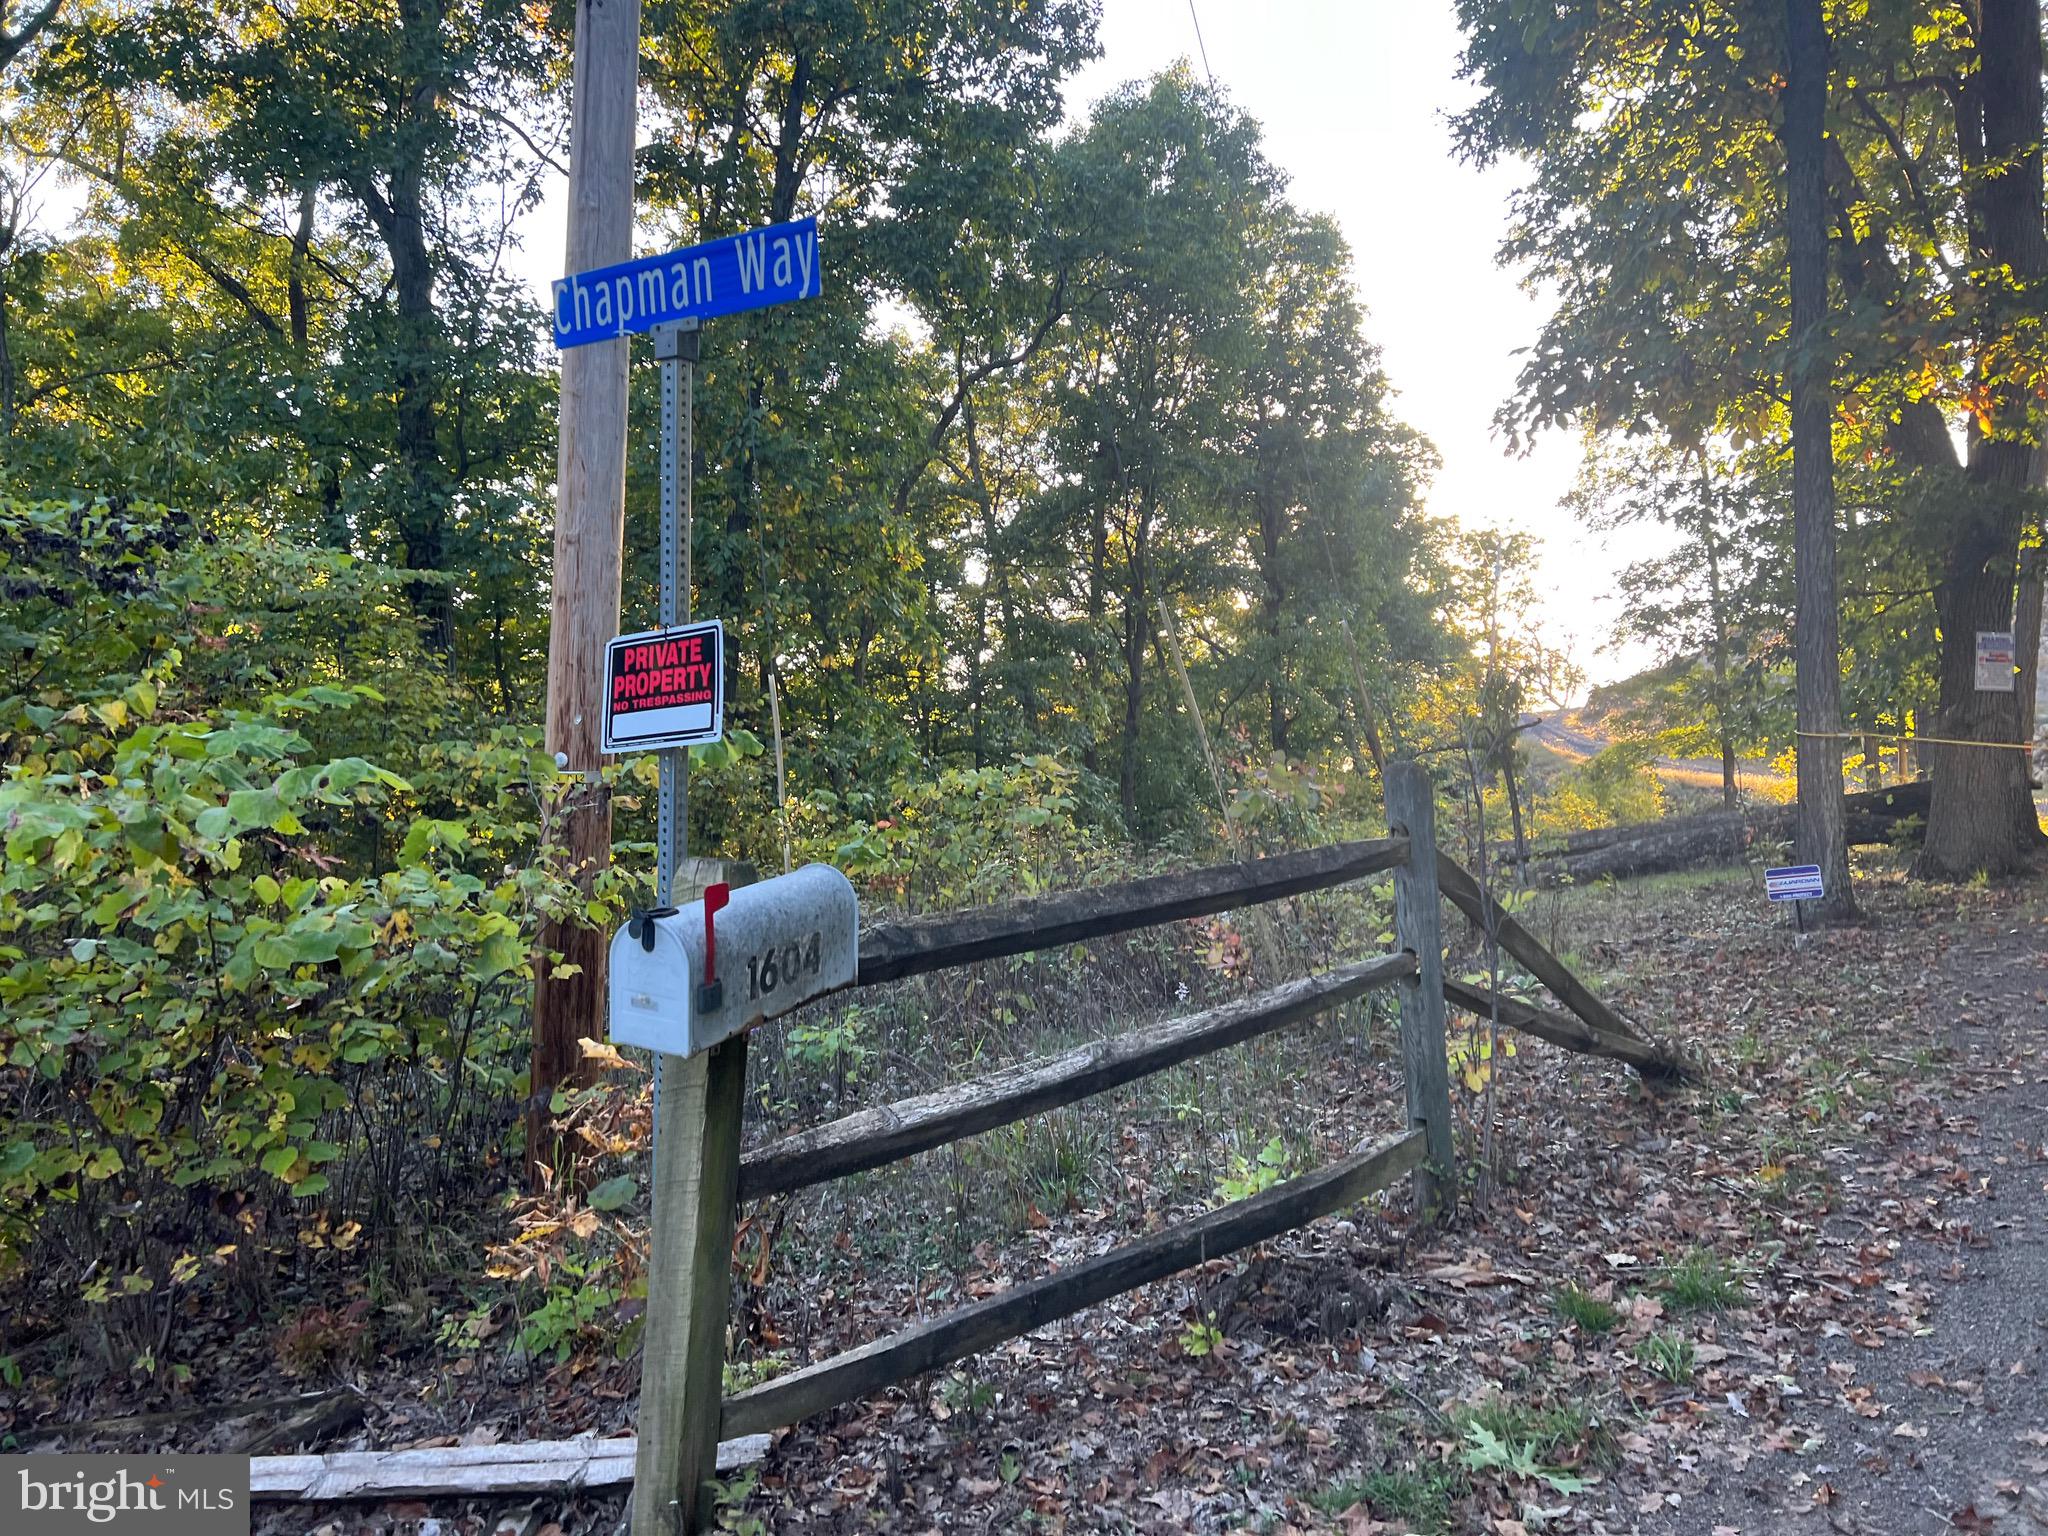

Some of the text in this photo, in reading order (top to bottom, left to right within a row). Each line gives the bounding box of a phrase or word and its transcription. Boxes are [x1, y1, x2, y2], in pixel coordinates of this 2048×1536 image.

[554, 231, 814, 337] Chapman Way
[624, 638, 702, 672] PRIVATE
[614, 663, 711, 699] PROPERTY
[614, 690, 712, 711] NO TRESPASSING
[748, 932, 822, 1001] 1604
